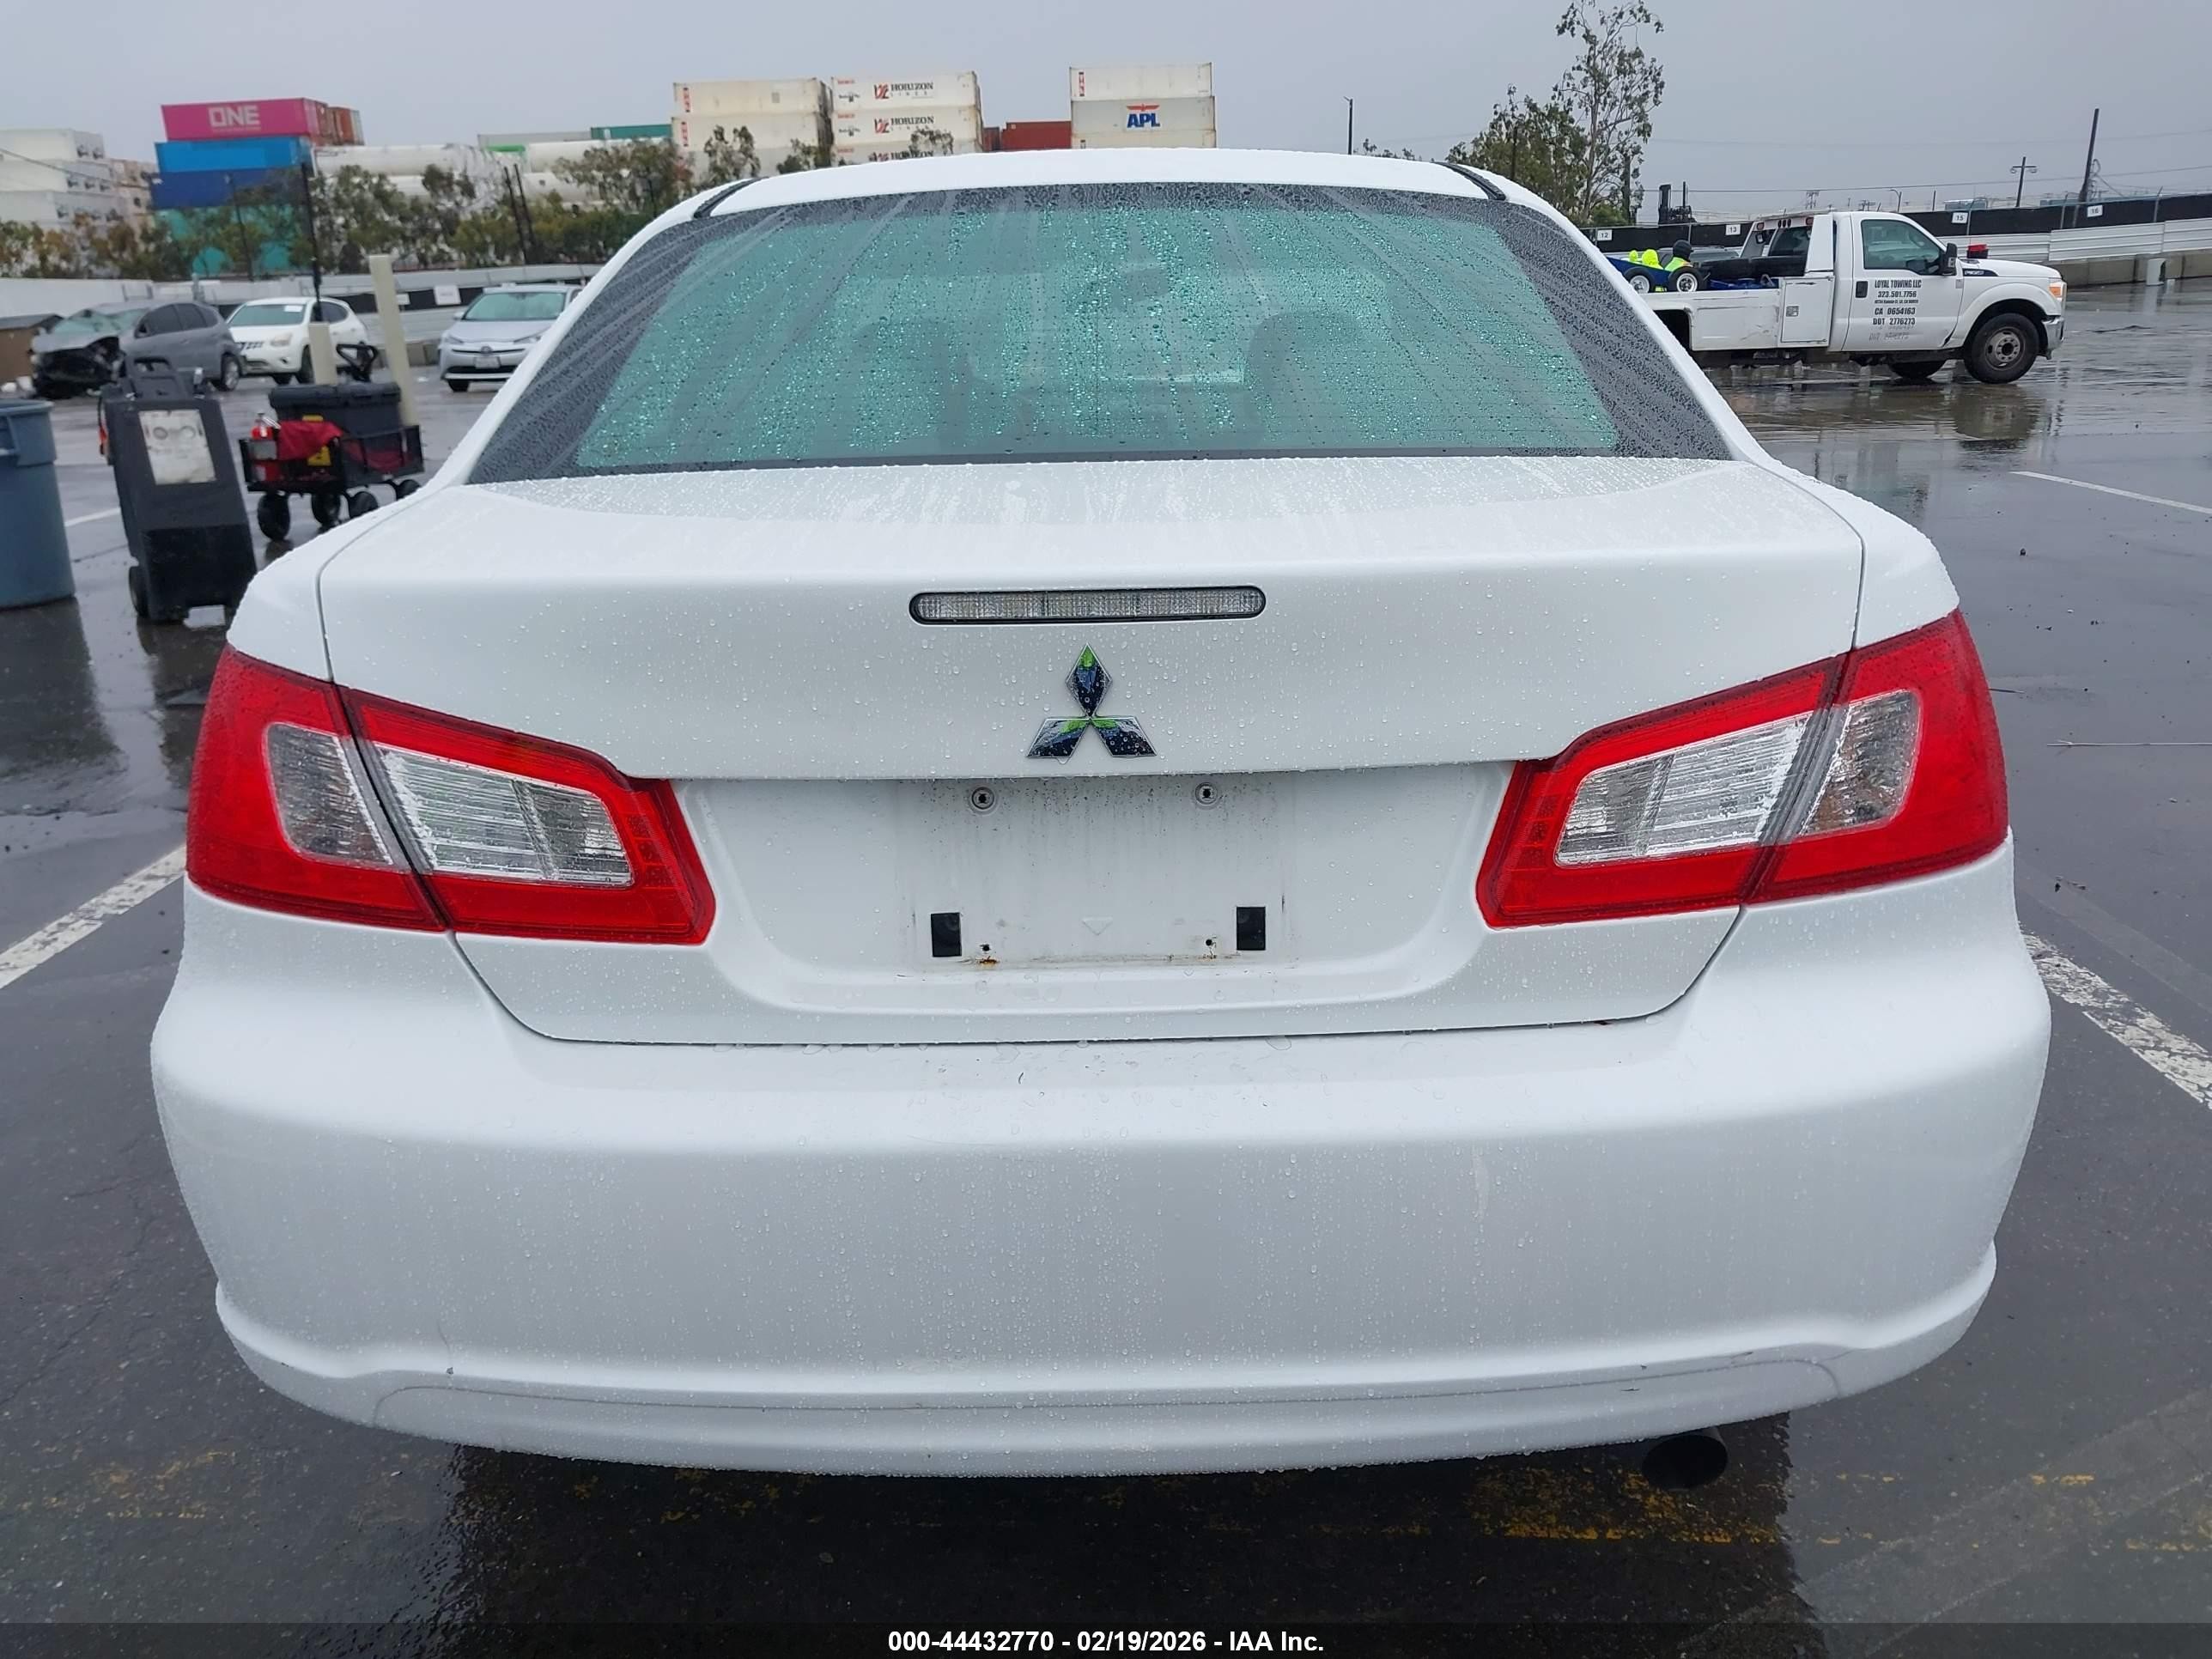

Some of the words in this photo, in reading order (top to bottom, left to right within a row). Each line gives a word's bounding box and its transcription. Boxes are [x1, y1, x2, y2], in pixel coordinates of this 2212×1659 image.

[890, 82, 933, 91] HORIZON
[208, 105, 260, 127] ONE
[890, 116, 934, 125] HORIZON
[1127, 112, 1160, 128] APL
[1875, 279, 1889, 289] LOYAL
[1891, 279, 1912, 288] TOWING
[1913, 279, 1922, 288] LLC
